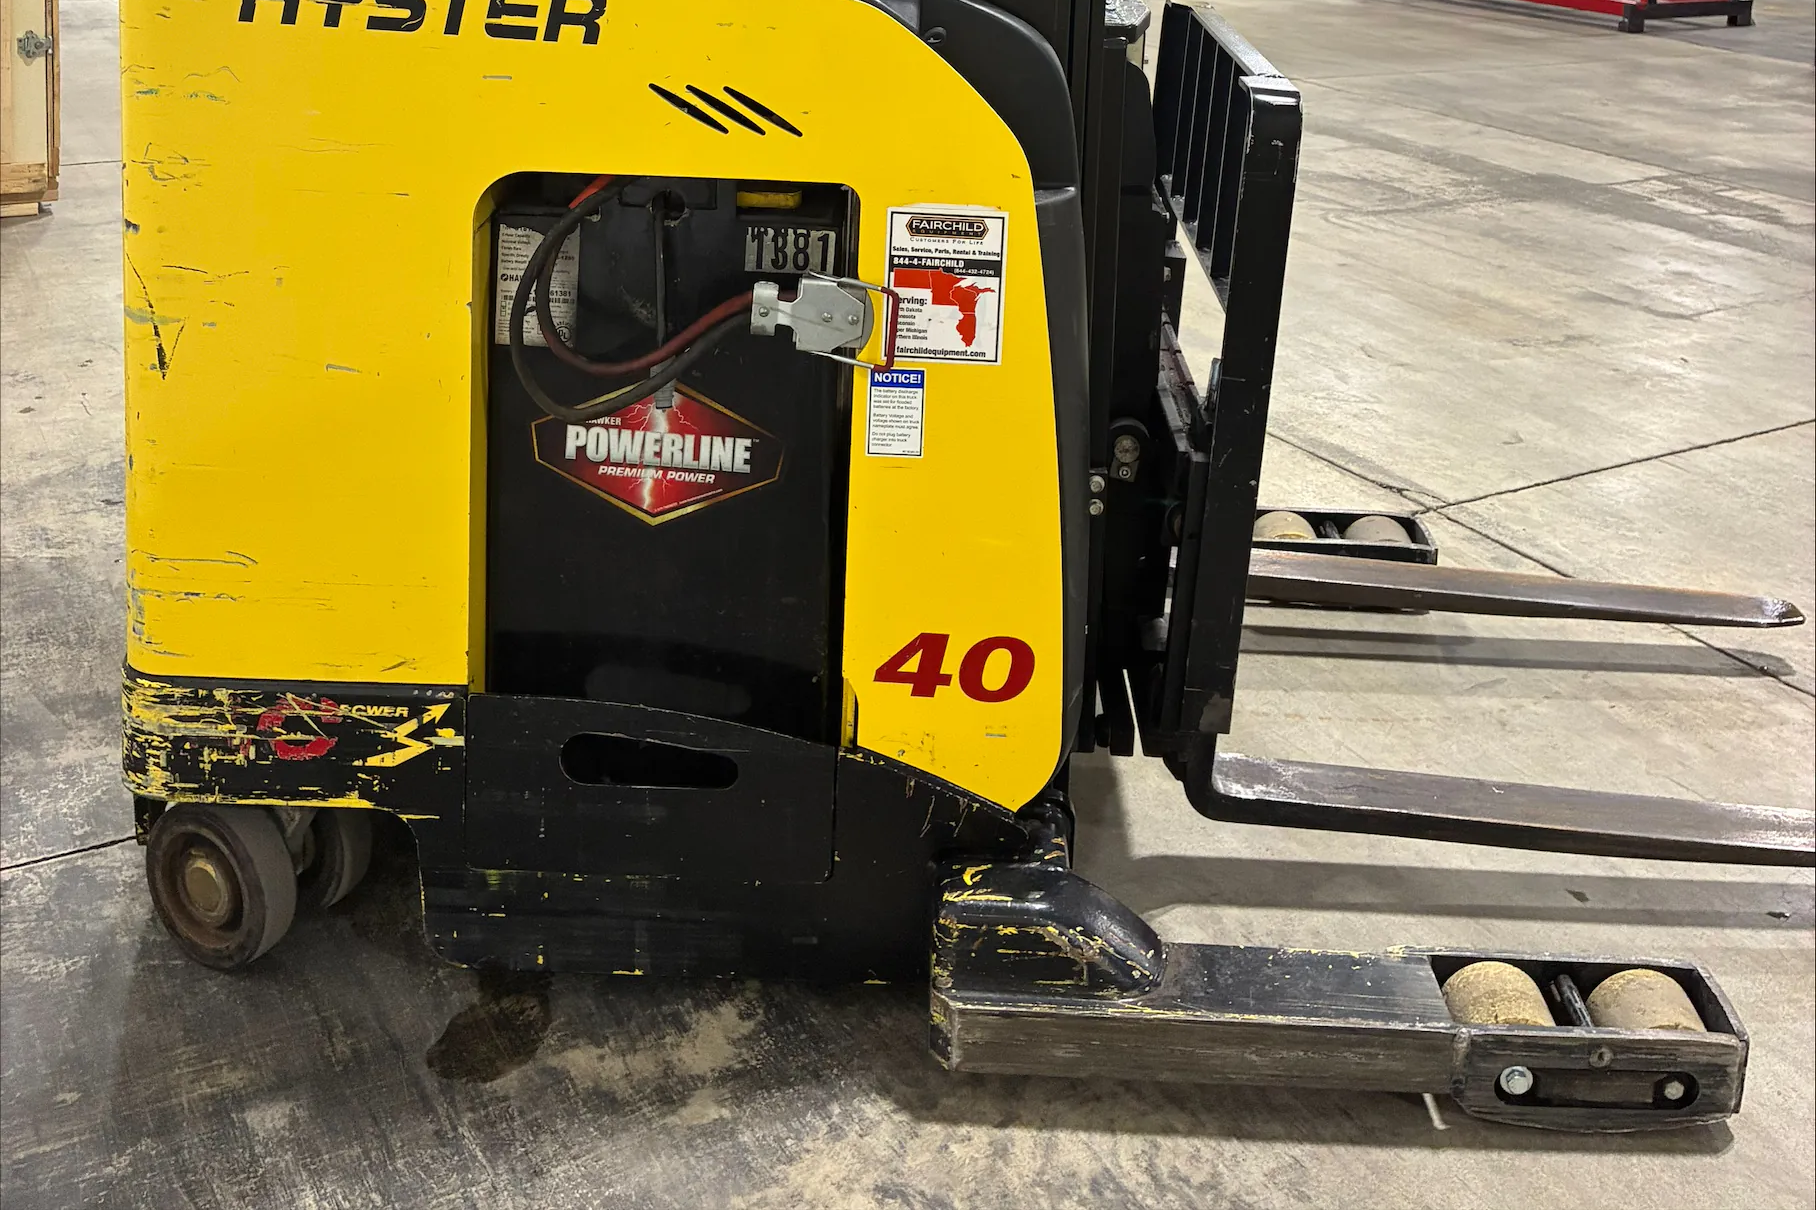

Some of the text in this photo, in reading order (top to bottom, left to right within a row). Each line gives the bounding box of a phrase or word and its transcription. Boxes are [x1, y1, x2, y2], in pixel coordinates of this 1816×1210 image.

[912, 220, 984, 232] FAIRCHILD
[893, 257, 964, 267] 844-4-FAIRCHILD
[899, 297, 927, 306] erving:
[896, 346, 986, 358] fairchildequipment.com
[874, 373, 921, 383] NOTICE!
[565, 424, 752, 473] POWERLINE
[598, 466, 716, 484] PREMIUM POWER
[872, 632, 1036, 703] 40
